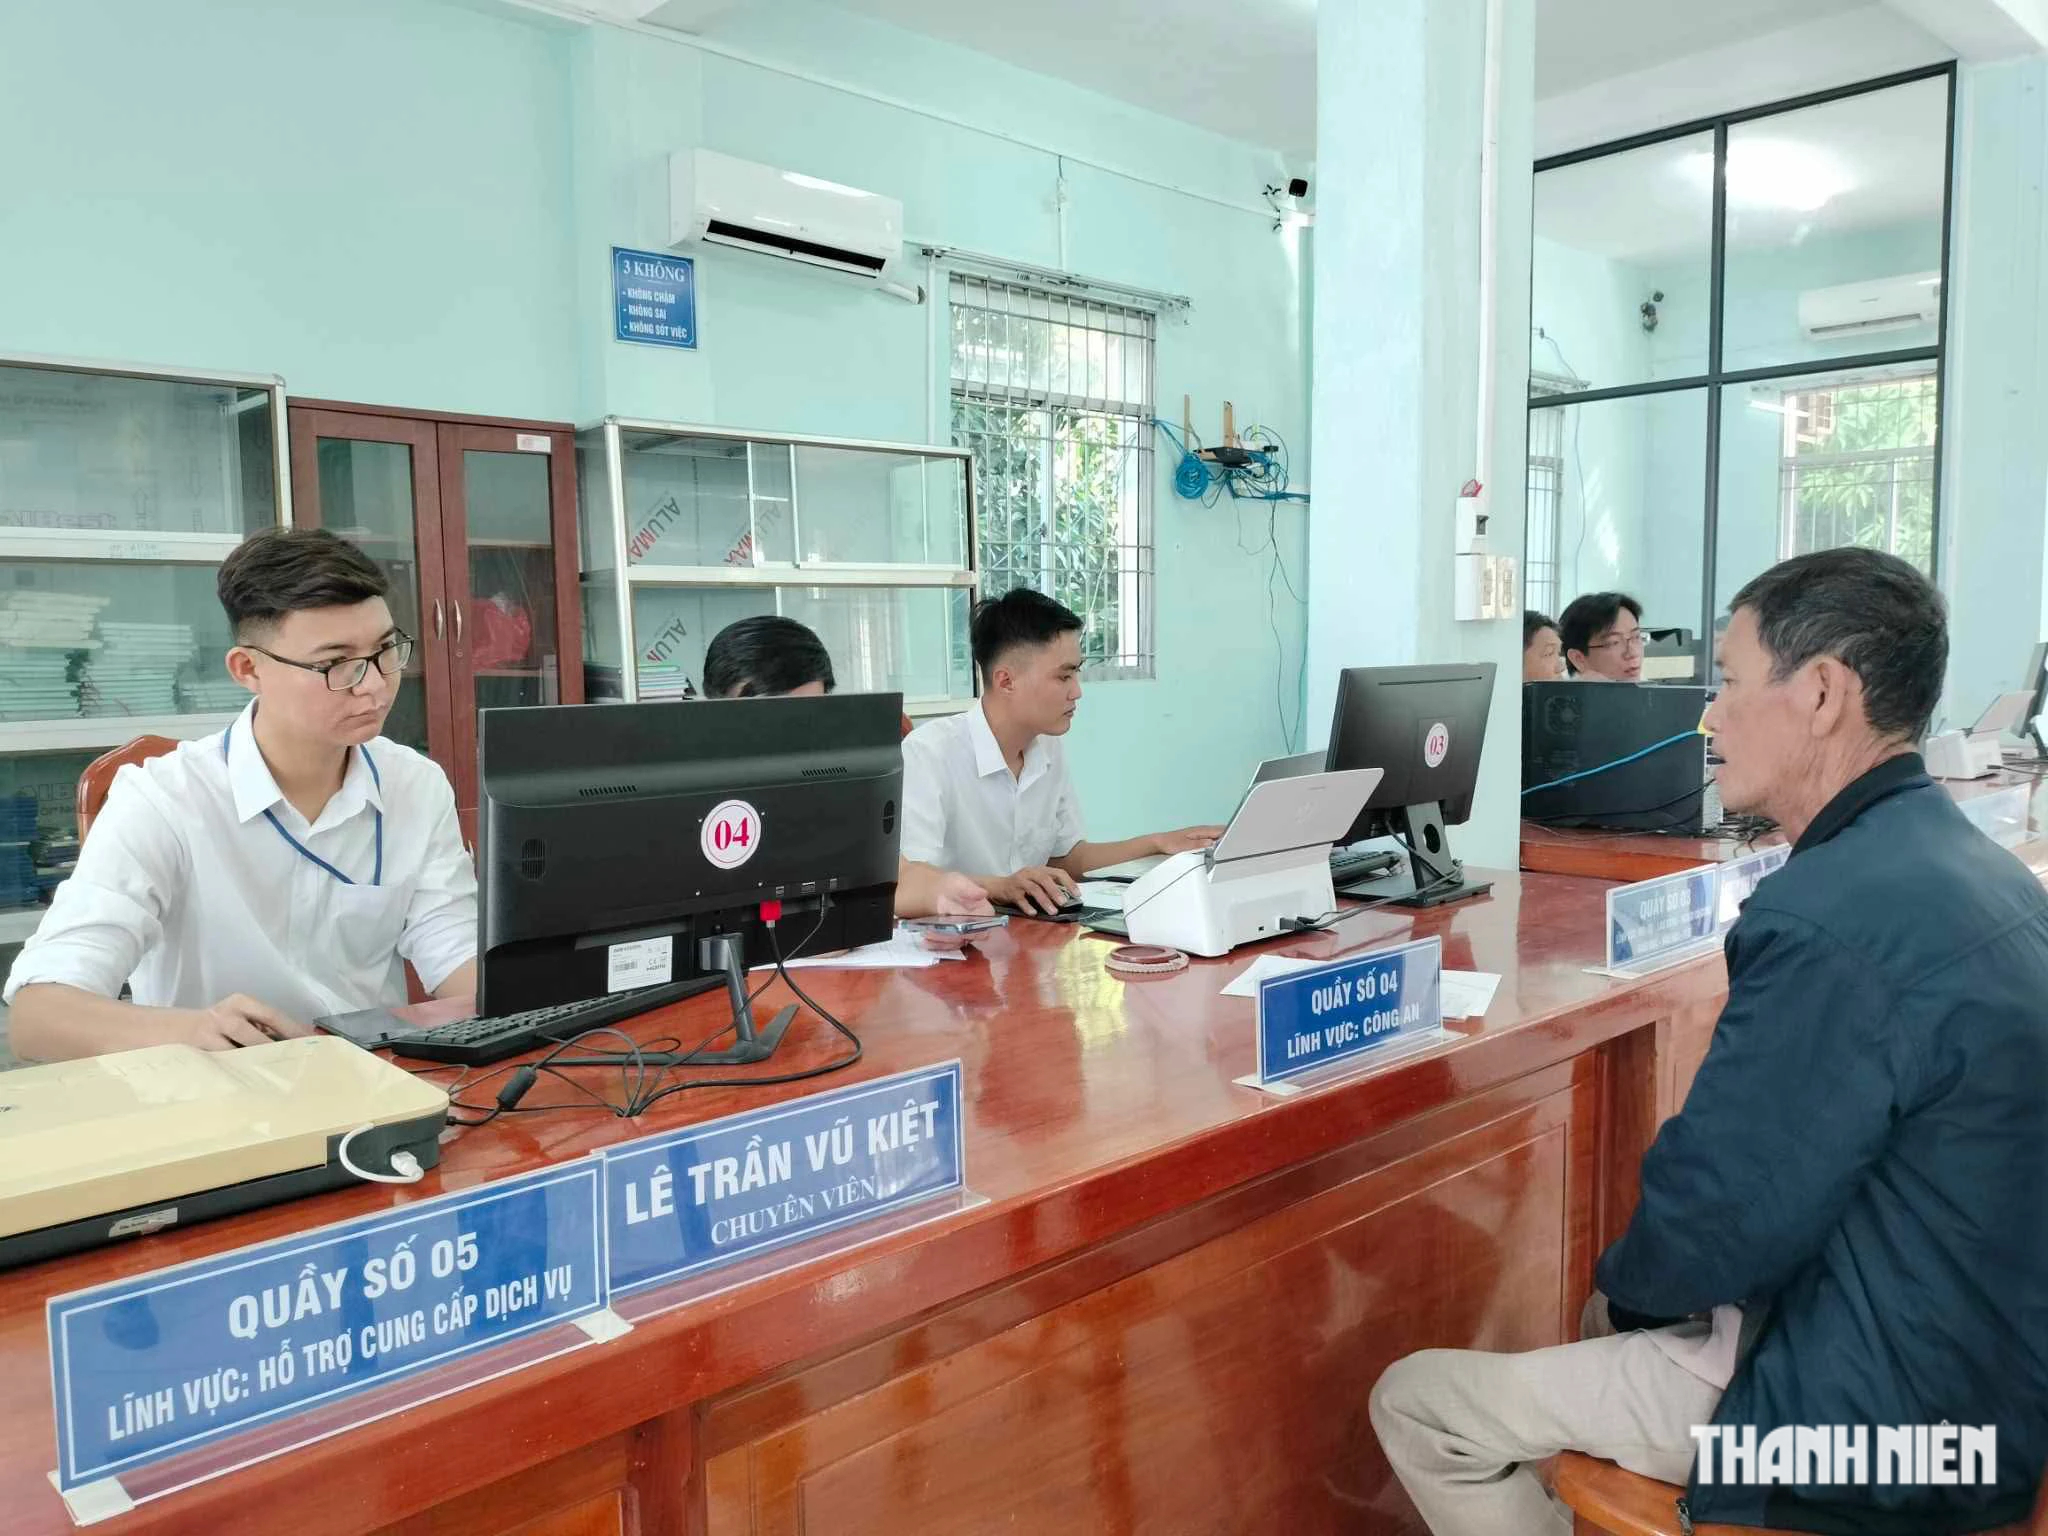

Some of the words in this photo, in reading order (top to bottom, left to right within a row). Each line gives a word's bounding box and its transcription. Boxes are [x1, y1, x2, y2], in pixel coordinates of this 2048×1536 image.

[623, 260, 631, 274] 3
[634, 261, 685, 283] KHÔNG
[628, 303, 654, 318] KHÔNG
[654, 307, 667, 320] SAI
[629, 321, 655, 335] KHÔNG
[655, 322, 669, 336] SÓT
[670, 325, 688, 340] VIỆC
[628, 497, 681, 565] ALUMA
[1430, 735, 1445, 755] 03
[714, 817, 750, 850] 04
[1311, 976, 1352, 1016] QUẦY
[1356, 967, 1377, 1002] SỐ
[1380, 970, 1398, 995] 04
[1287, 1031, 1321, 1059] LĨNH
[1325, 1021, 1359, 1048] VỰC:
[1363, 1009, 1399, 1036] CÔNG
[1403, 1001, 1420, 1025] AN
[625, 1164, 673, 1225] LÊ
[688, 1133, 792, 1206] TRẦN
[805, 1116, 853, 1172] VŨ
[867, 1099, 939, 1155] KIỆT
[711, 1193, 815, 1245] CHUYÊN
[820, 1175, 877, 1211] VIÊN
[228, 1262, 348, 1340] QUẦY
[363, 1233, 419, 1299] SỐ
[430, 1231, 479, 1279] 05
[108, 1387, 175, 1441] LĨNH
[183, 1366, 250, 1416] VỰC:
[258, 1337, 295, 1392] HỖ
[302, 1327, 353, 1377] TRỢ
[360, 1310, 425, 1359] CUNG
[433, 1285, 479, 1335] CẤP
[485, 1274, 538, 1321] DỊCH
[543, 1264, 573, 1301] VỤ
